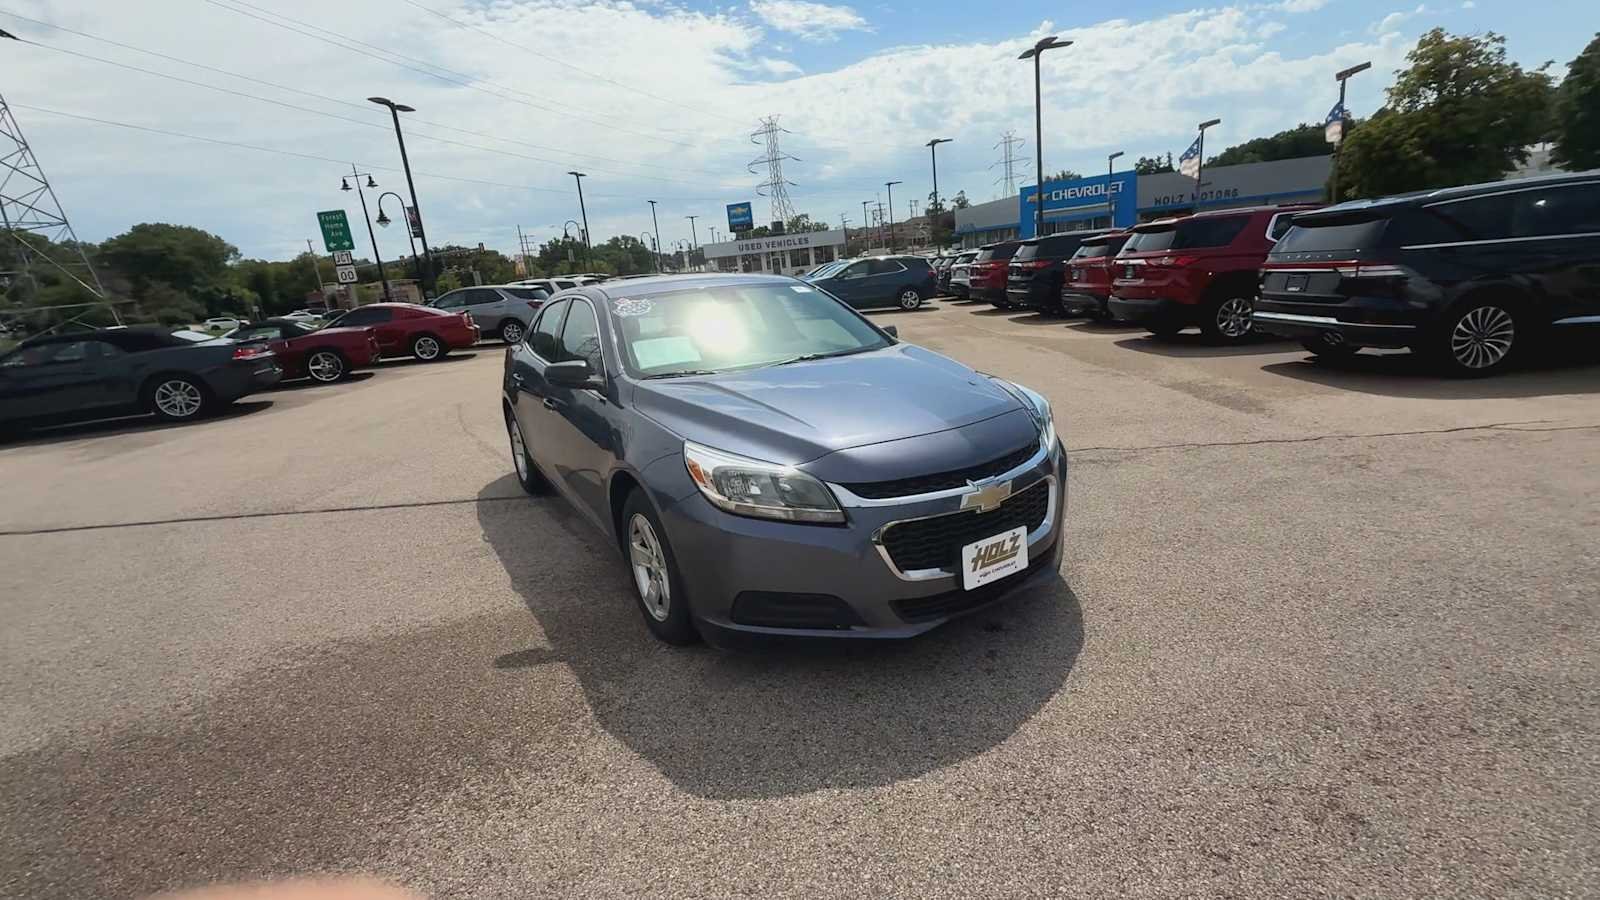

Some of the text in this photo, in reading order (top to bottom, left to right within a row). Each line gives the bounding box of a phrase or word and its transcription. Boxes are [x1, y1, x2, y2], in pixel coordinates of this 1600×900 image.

[1052, 181, 1125, 200] CHEVROLET
[1154, 194, 1184, 205] HOLZ
[738, 237, 809, 252] USED VEHICLES
[336, 253, 350, 263] JCT
[971, 534, 1021, 572] HOLZ
